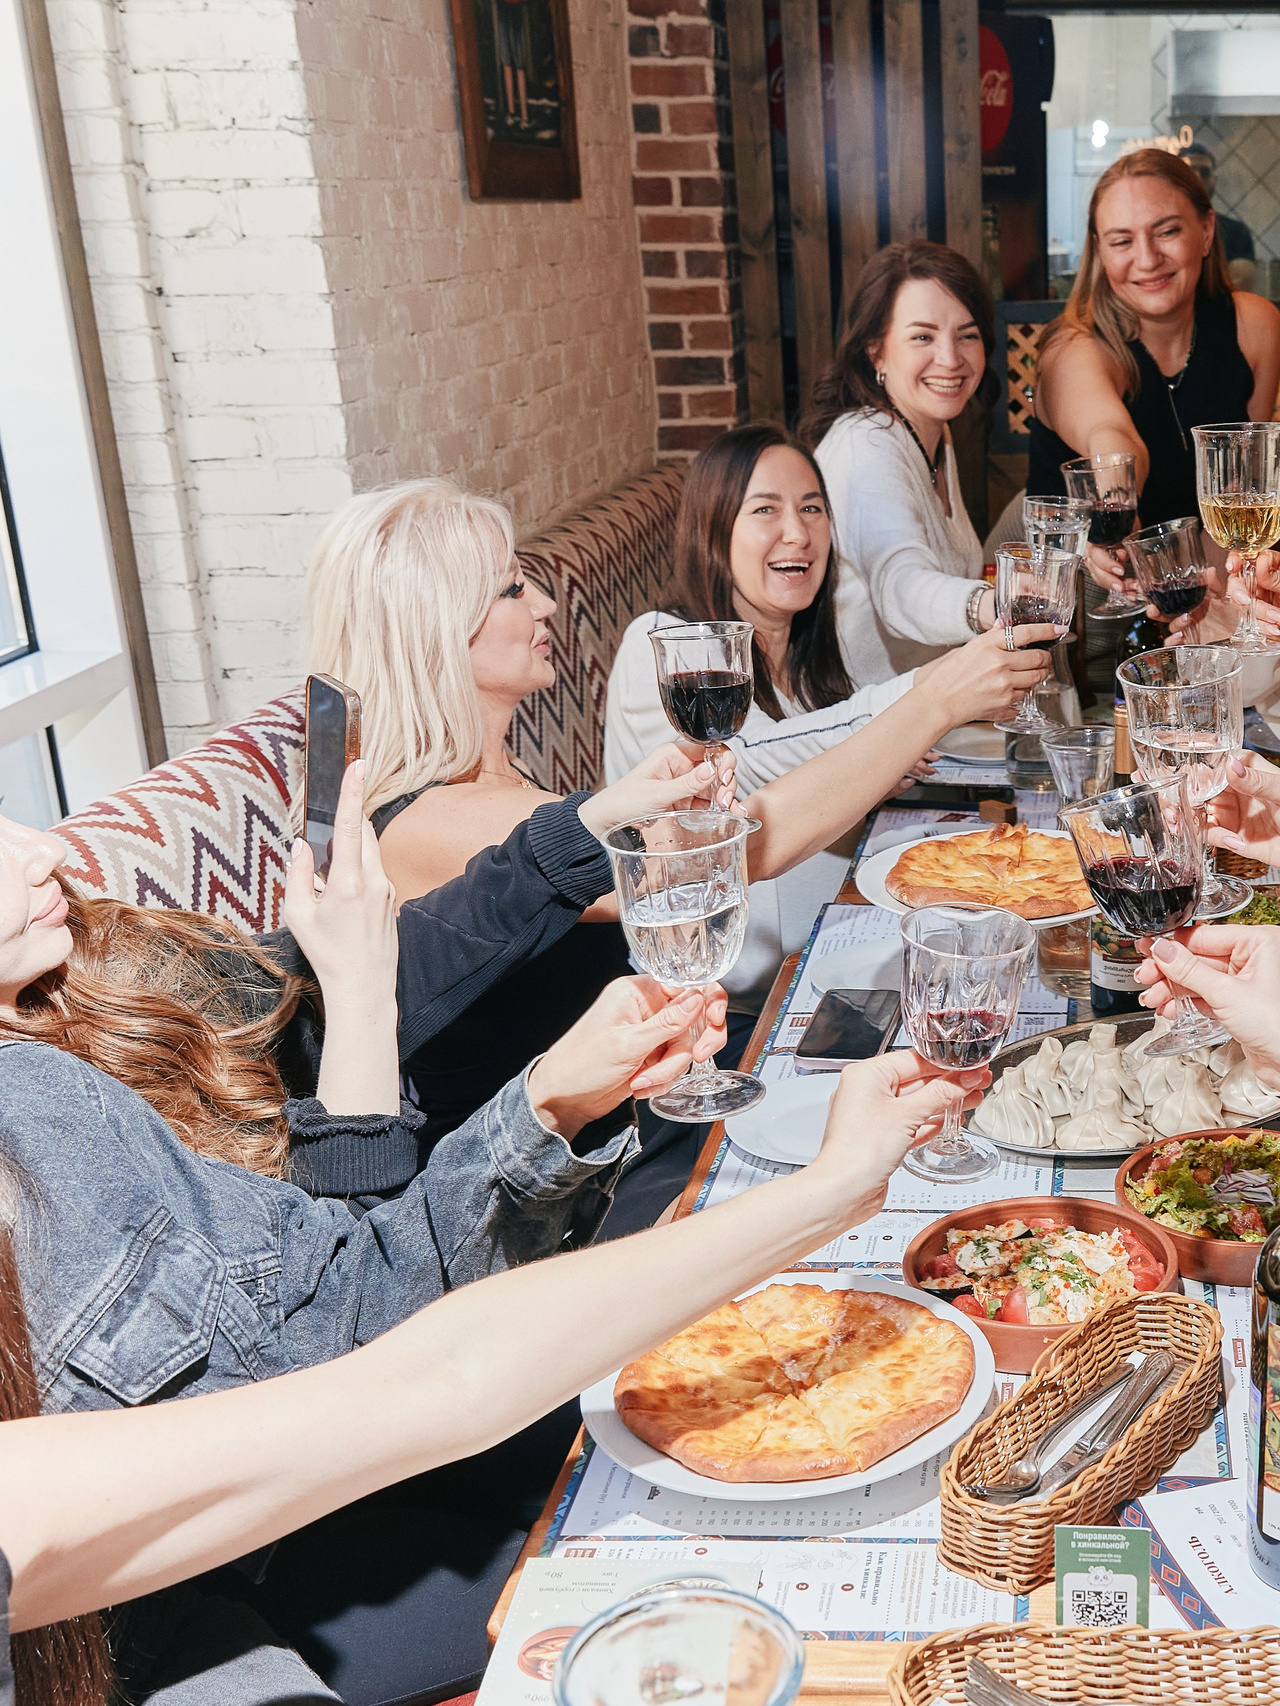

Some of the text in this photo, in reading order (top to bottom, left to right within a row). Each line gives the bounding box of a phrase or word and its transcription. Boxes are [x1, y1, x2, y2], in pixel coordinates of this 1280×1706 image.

[1072, 1531, 1126, 1542] Понравилось
[1077, 1541, 1130, 1550] хинкальной?
[871, 1552, 887, 1606] Как правильно
[1188, 1536, 1238, 1595] АЛКОГОЛЬ
[860, 1568, 871, 1600] хинкали:
